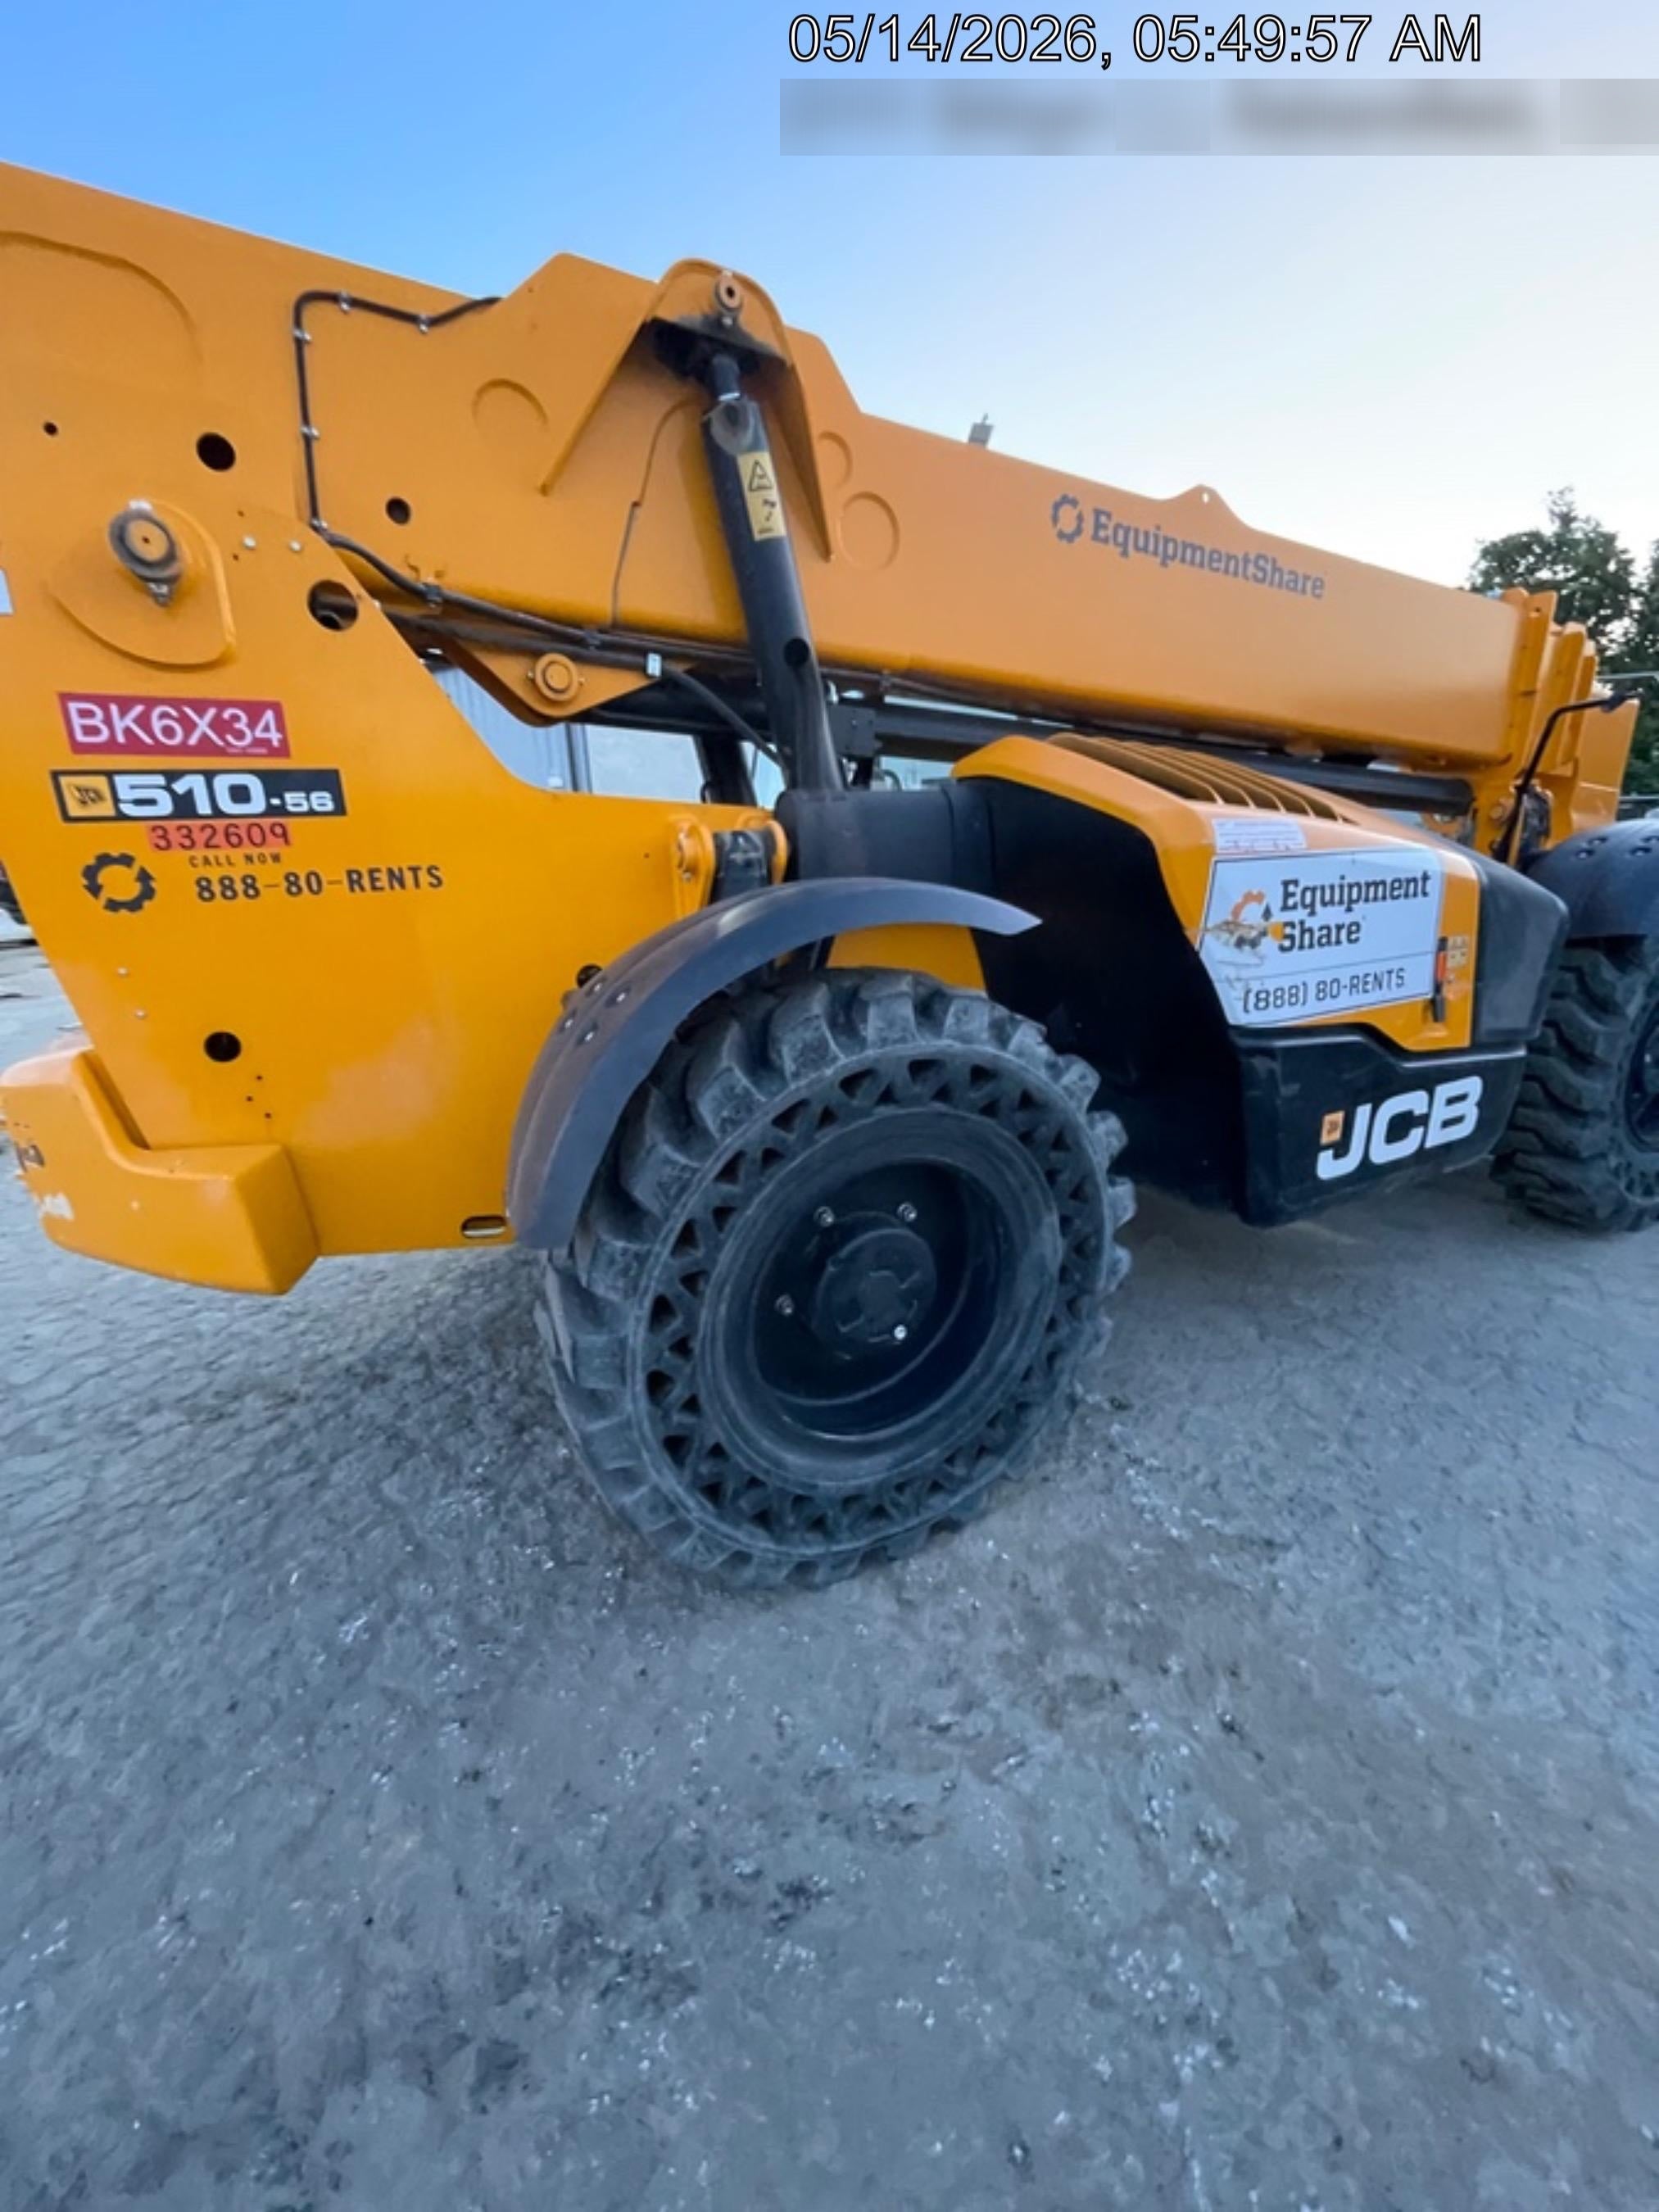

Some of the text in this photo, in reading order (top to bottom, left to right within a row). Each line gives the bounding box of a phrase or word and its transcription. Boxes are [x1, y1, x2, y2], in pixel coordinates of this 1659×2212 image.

[1090, 507, 1325, 599] EquipmentShare
[67, 700, 283, 748] BK6X34
[152, 822, 291, 851] 332609
[189, 853, 283, 868] CALL NOW
[195, 865, 444, 903] 888-80-RENTS
[1280, 870, 1430, 912] Equipment
[1278, 918, 1362, 953] Share
[1243, 968, 1405, 1013] (888) 80-RENTS
[1316, 1076, 1483, 1181] JCB
